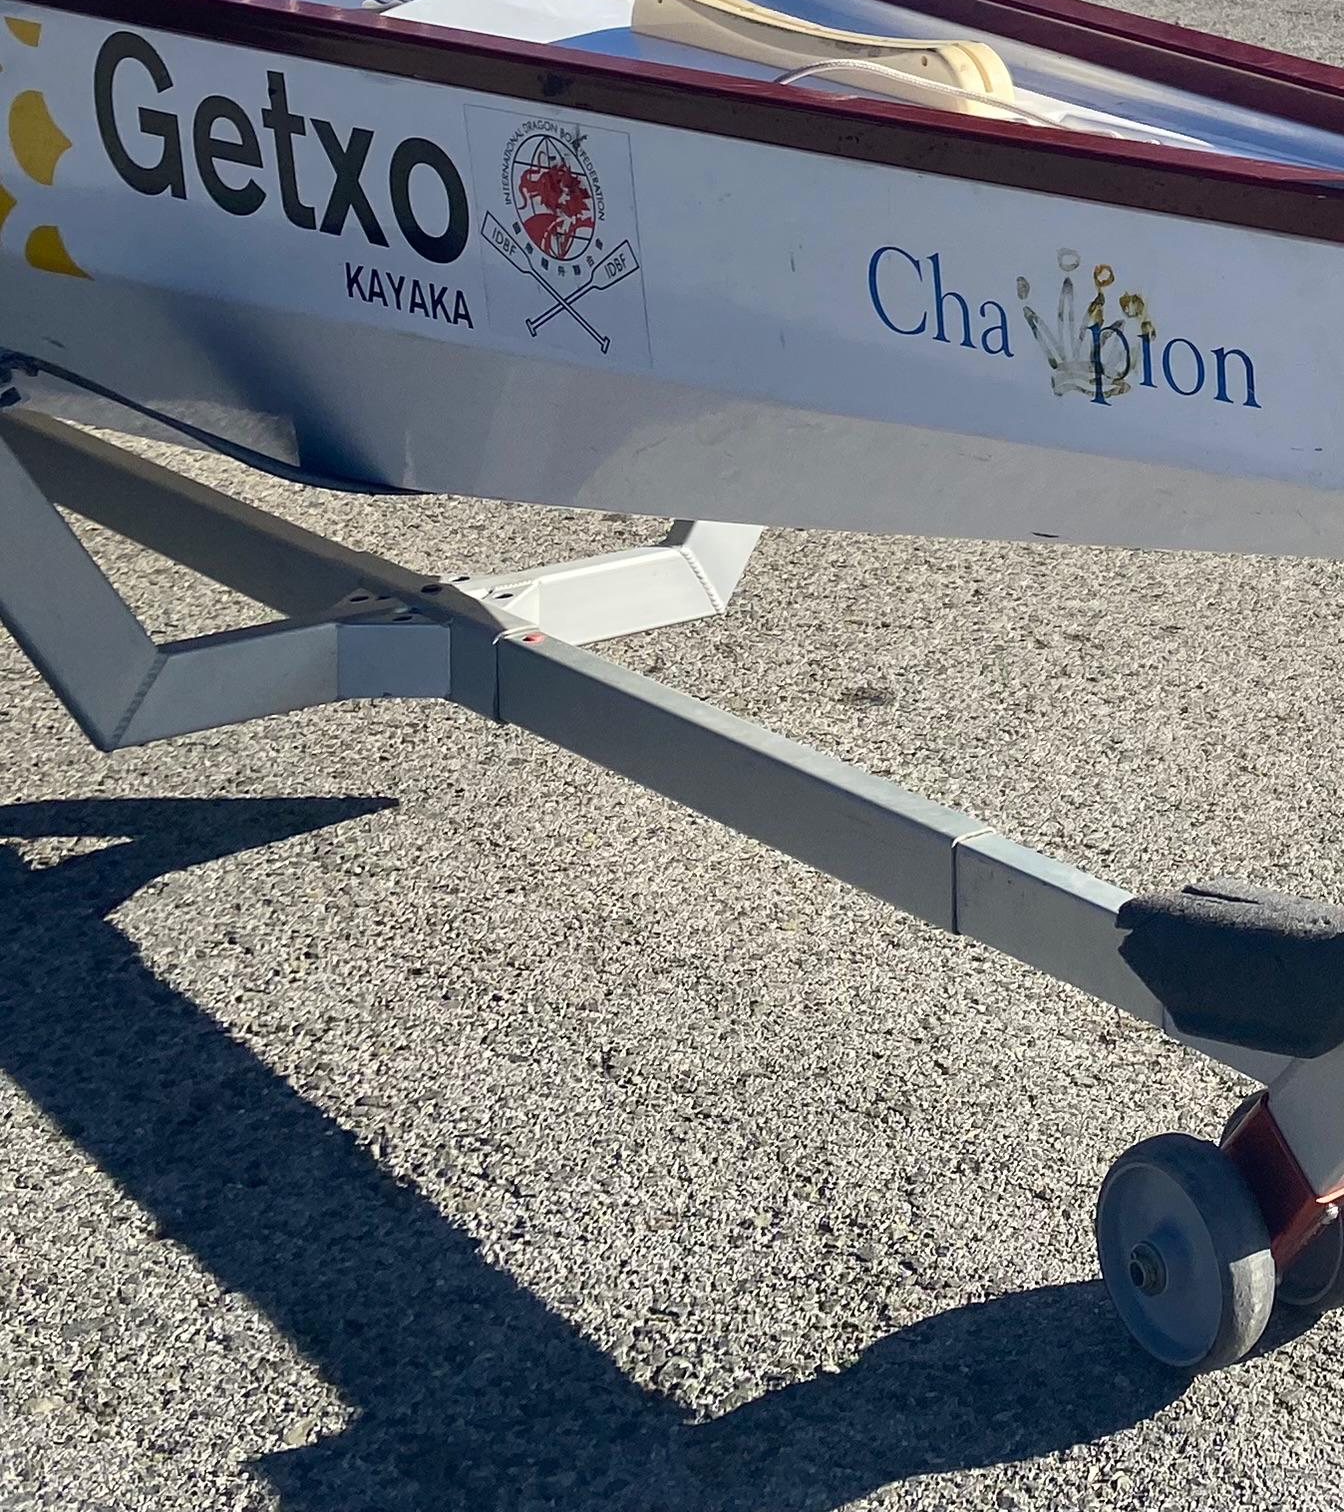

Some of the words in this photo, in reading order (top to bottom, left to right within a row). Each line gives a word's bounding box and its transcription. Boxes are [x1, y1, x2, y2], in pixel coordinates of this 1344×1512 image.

[94, 30, 470, 264] Getxo
[502, 129, 524, 206] INTERNATIONAL
[521, 120, 558, 133] DRAGON
[579, 150, 606, 222] FEDERATION
[491, 227, 518, 256] IDBF
[604, 253, 628, 280] IDBF
[345, 261, 474, 330] KAYAKA
[868, 246, 1262, 408] Chapion
